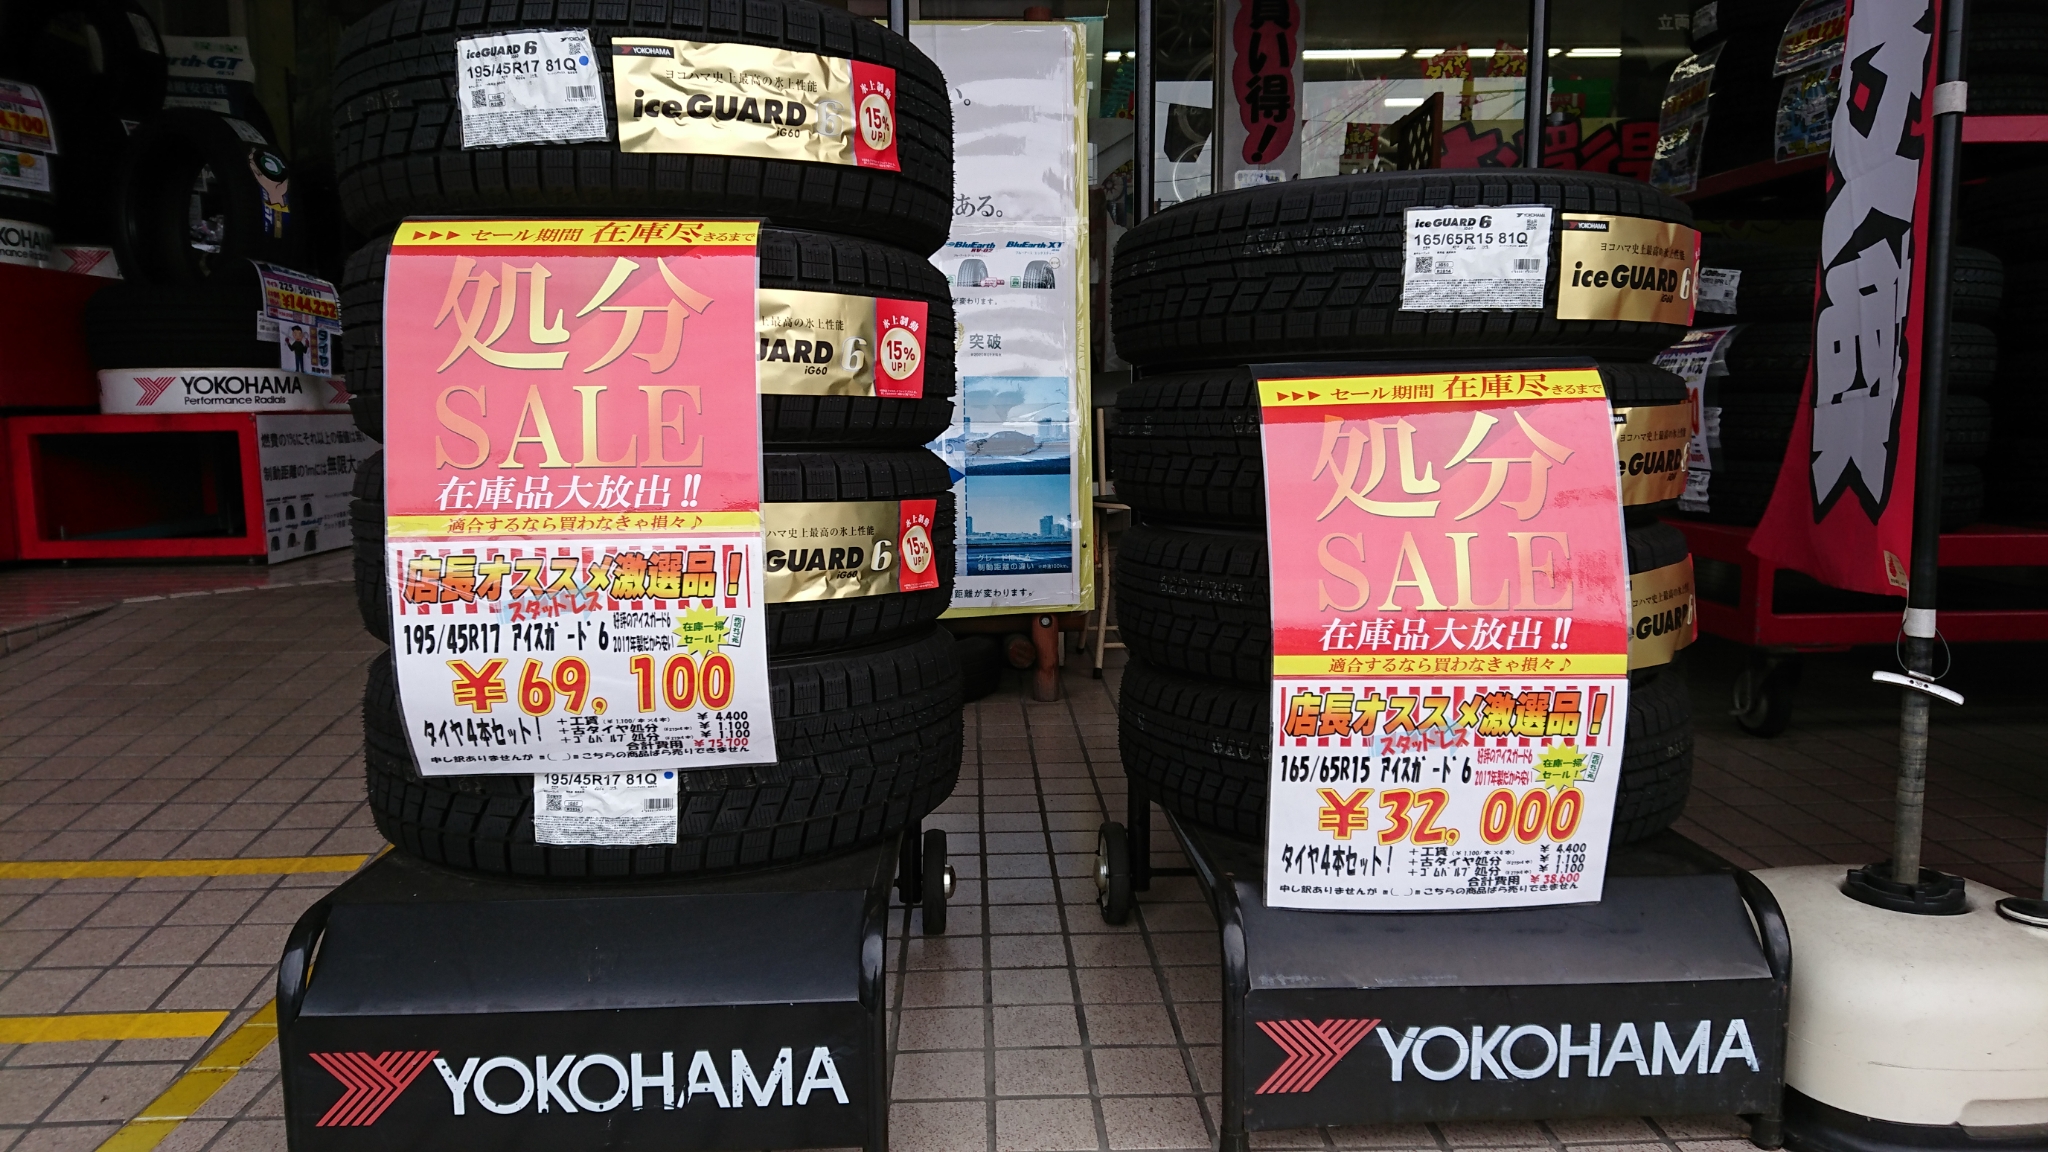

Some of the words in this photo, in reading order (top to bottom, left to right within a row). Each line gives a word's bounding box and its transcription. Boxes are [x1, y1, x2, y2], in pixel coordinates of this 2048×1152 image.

[524, 41, 538, 55] 6
[632, 46, 671, 56] YOKOHAMA
[467, 60, 539, 79] 195/45R17
[546, 57, 577, 73] 81Q
[665, 69, 818, 93] ヨコハマ史上最高の氷上性能
[633, 88, 807, 127] iceGUARD
[816, 99, 844, 137] 6
[865, 106, 890, 132] 15%
[776, 127, 801, 139] iG60
[870, 131, 886, 143] UP!
[1415, 217, 1476, 229] iceGUARD
[1479, 215, 1492, 229] 6
[1578, 222, 1607, 230] YOKOHAMA
[470, 228, 585, 243] セール期間
[589, 221, 756, 244] 在庫尽きるまで
[1415, 232, 1494, 246] 165/65R15
[1498, 232, 1528, 246] 81Q
[1571, 261, 1678, 293] iceGUARD
[1680, 266, 1691, 300] 6
[433, 255, 716, 375] 処分
[882, 315, 919, 332] 氷上制動
[886, 340, 915, 361] 15%
[969, 333, 1002, 350] 突破
[840, 336, 868, 372] 6
[804, 365, 828, 376] iG60
[891, 362, 907, 373] UP!
[180, 376, 303, 395] YOKOHAMA
[1330, 384, 1434, 401] セール期間
[1443, 373, 1602, 400] 在庫尽きるまで
[184, 396, 253, 406] Performance
[434, 383, 705, 470] SALE
[1311, 410, 1576, 523] 処分
[766, 546, 864, 573] GUARD
[870, 538, 893, 572] 6
[906, 536, 929, 556] 15%
[912, 555, 925, 566] UP!
[402, 550, 742, 605] 店長オススメ激選品!
[1316, 531, 1574, 613] SALE
[507, 590, 604, 623] スタッドレス
[683, 621, 725, 632] 在庫一掃
[404, 622, 500, 655] 195/45R17
[613, 635, 675, 653] 2017年製だから安い
[1284, 691, 1609, 739] 店長オススメ激選品!
[626, 740, 684, 751] 合計費用
[1379, 726, 1471, 757] スタッドレス
[430, 753, 533, 764] 申し訳ありませんが
[1542, 758, 1583, 768] 在庫一掃
[544, 773, 621, 785] 195/45R17
[626, 773, 657, 784] 81Q
[1281, 755, 1371, 784] 165/65R15
[1279, 885, 1378, 896] 申し訳ありませんが
[1467, 875, 1521, 887] 合計費用
[1376, 1017, 1762, 1083] YOKOHAMA
[433, 1046, 850, 1116] YOKOHAMA
